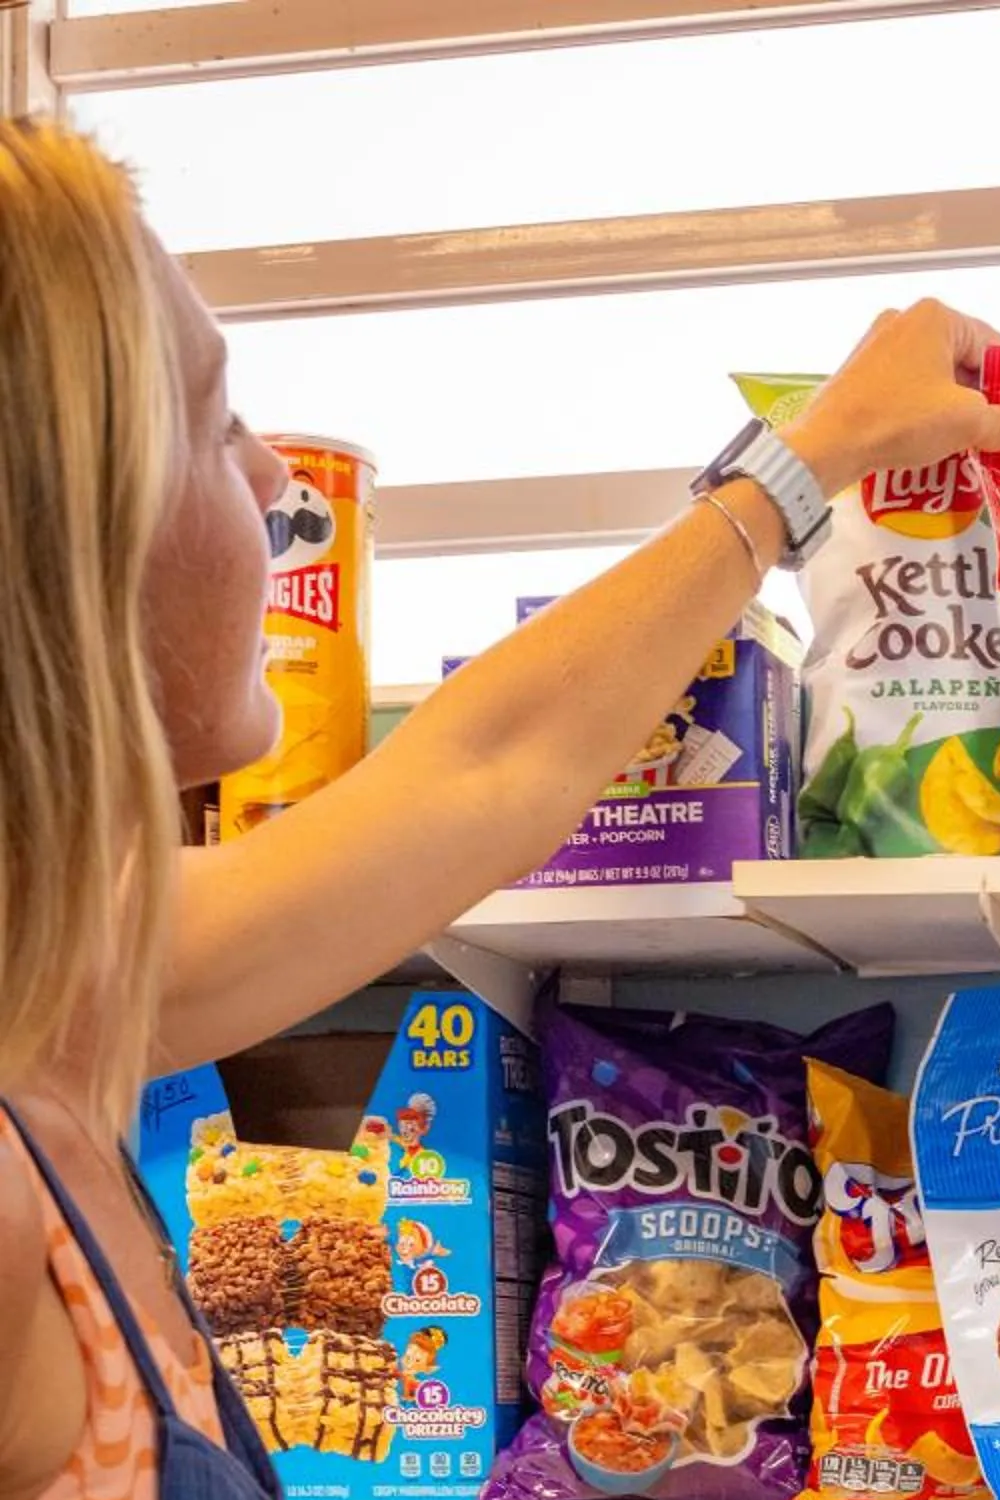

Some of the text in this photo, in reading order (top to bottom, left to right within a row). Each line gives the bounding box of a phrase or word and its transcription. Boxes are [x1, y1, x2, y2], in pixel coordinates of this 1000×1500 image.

[856, 546, 997, 619] Kettl
[268, 569, 333, 622] GLES
[588, 801, 703, 827] THEATRE
[600, 829, 665, 844] POPCORN
[408, 1004, 475, 1047] 40
[412, 1050, 469, 1069] BARS
[390, 1180, 466, 1197] Rainbow
[673, 1240, 736, 1257] ORIGINAL
[422, 1275, 438, 1291] 15
[385, 1297, 477, 1313] Chocolate
[424, 1387, 442, 1404] 15
[384, 1408, 484, 1426] Chocolatey
[405, 1423, 463, 1437] DRIZZLE
